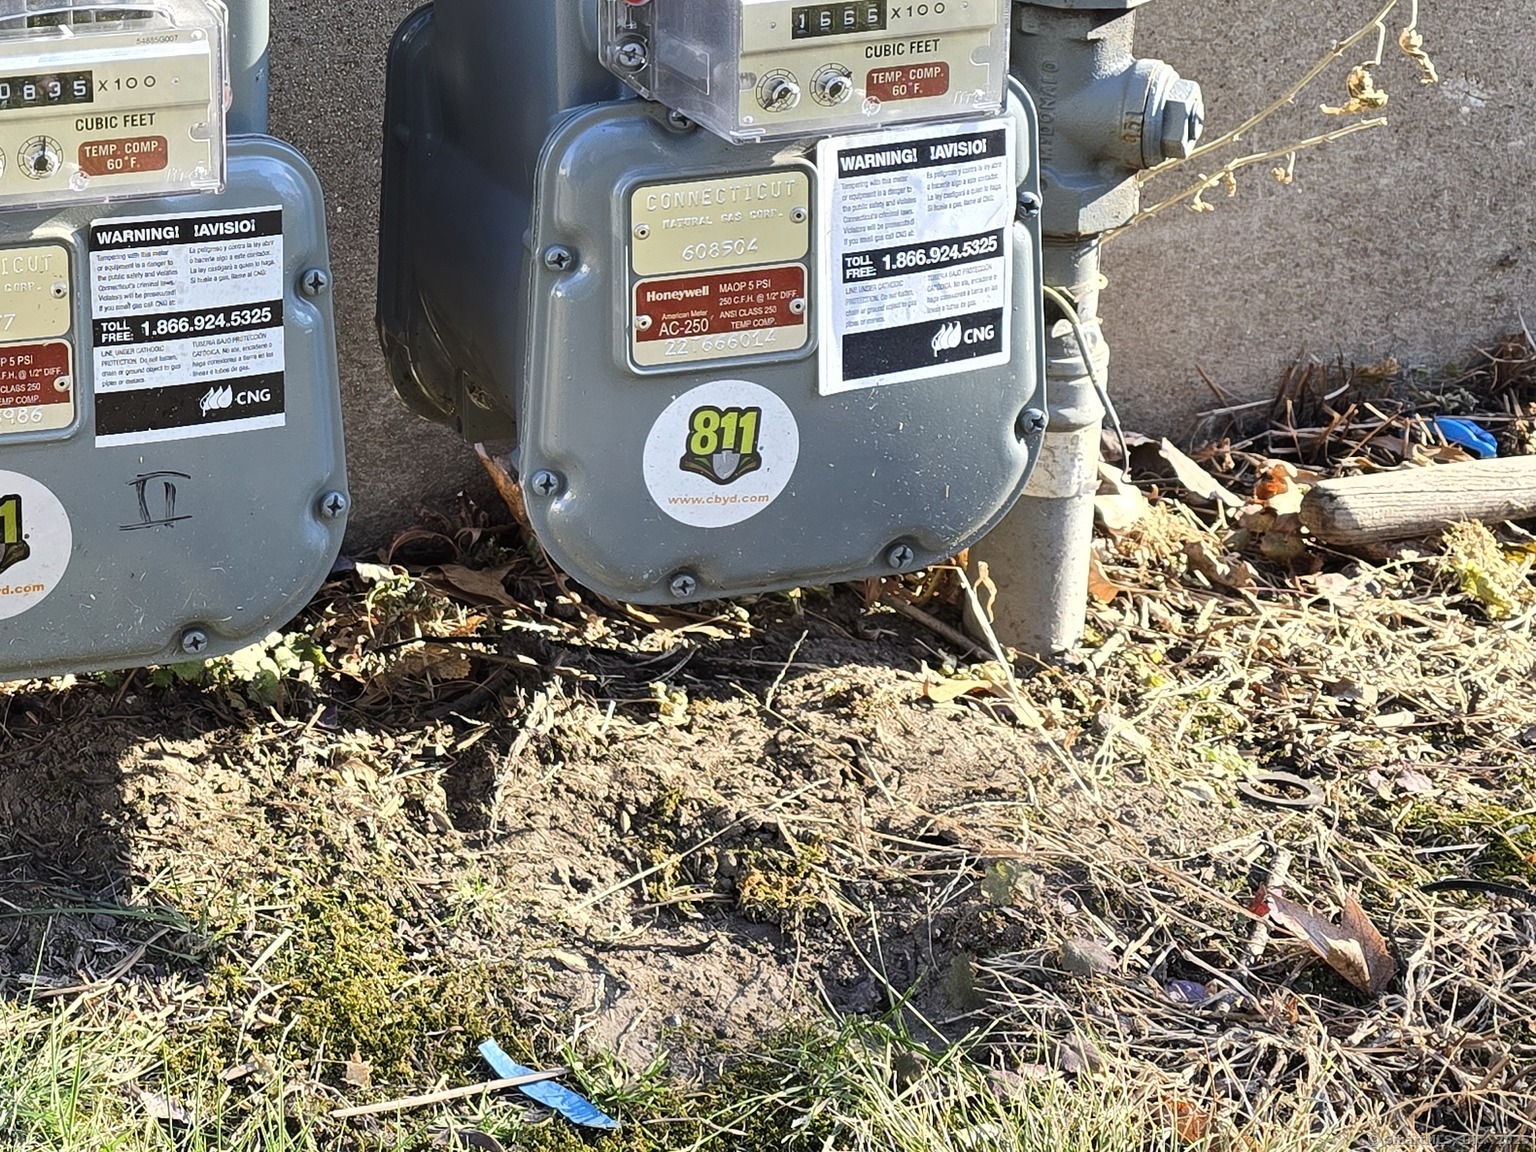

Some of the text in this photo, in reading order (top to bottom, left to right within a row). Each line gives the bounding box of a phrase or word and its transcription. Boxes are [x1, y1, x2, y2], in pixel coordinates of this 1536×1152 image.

[866, 39, 940, 58] CUBIC FEET
[909, 67, 944, 79] COMP.
[76, 113, 155, 131] CUBIC FEET
[125, 141, 163, 153] COMP.
[840, 148, 917, 171] WARNING!
[647, 179, 795, 211] CONNECTICUT
[663, 216, 712, 229] NATURAL
[721, 213, 742, 222] GAS
[97, 226, 179, 244] WARNING!
[845, 255, 873, 267] TOLL
[883, 236, 998, 270] 1.866.924.5325
[719, 279, 771, 292] MAOP 5 PSI
[647, 286, 709, 302] Honeywell
[719, 297, 732, 306] 250
[720, 305, 777, 319] ANSI CLASS 250
[101, 319, 130, 332] TOLL
[141, 307, 271, 336] 1.866.924.5325
[659, 318, 709, 336] AC-250
[731, 320, 751, 329] TEMP
[101, 332, 133, 343] FREE:
[964, 325, 994, 344] CNG
[9, 357, 15, 365] 5
[18, 355, 33, 365] PSI
[0, 384, 26, 393] CLASS
[27, 383, 40, 391] 250
[237, 389, 270, 405] CNG
[691, 409, 757, 456] 811
[668, 494, 769, 506] www.cbyd.com
